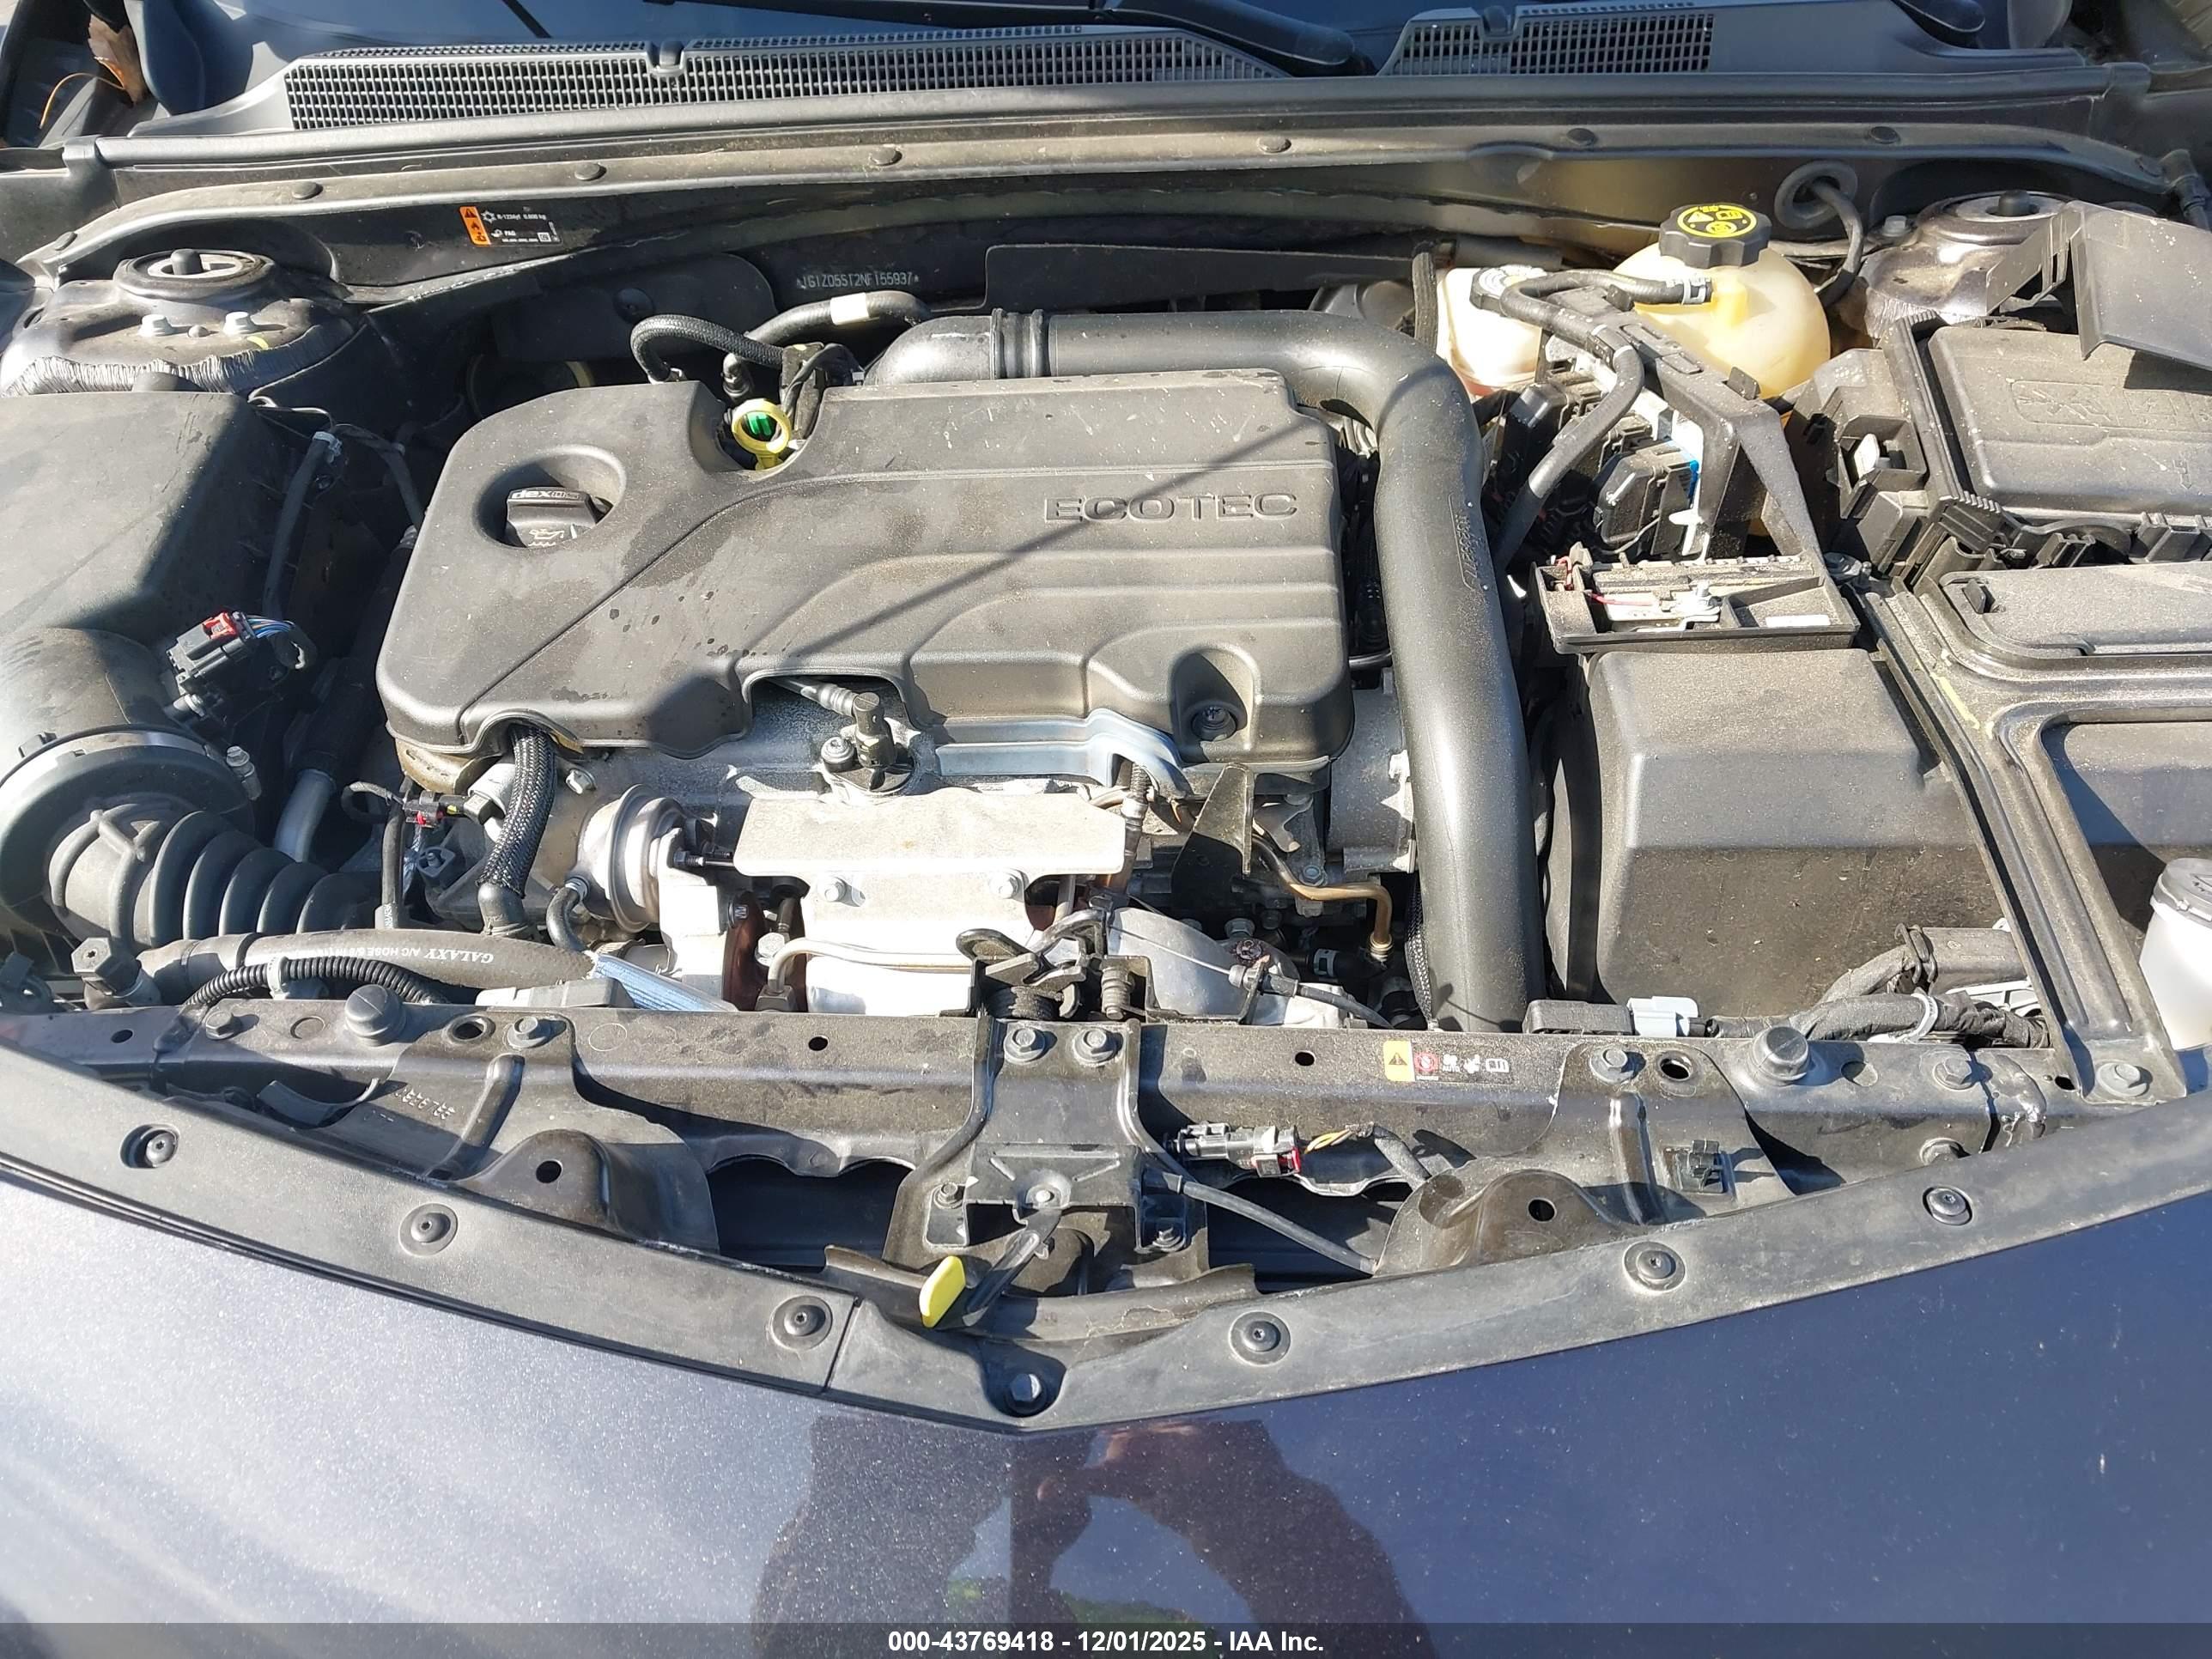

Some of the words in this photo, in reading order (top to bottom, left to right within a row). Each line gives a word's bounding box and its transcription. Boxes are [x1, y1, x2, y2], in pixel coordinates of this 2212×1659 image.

[1044, 492, 1299, 522] ECOTEC
[367, 946, 398, 957] HOSE
[398, 947, 421, 957] A/C
[424, 947, 495, 963] GALAXY
